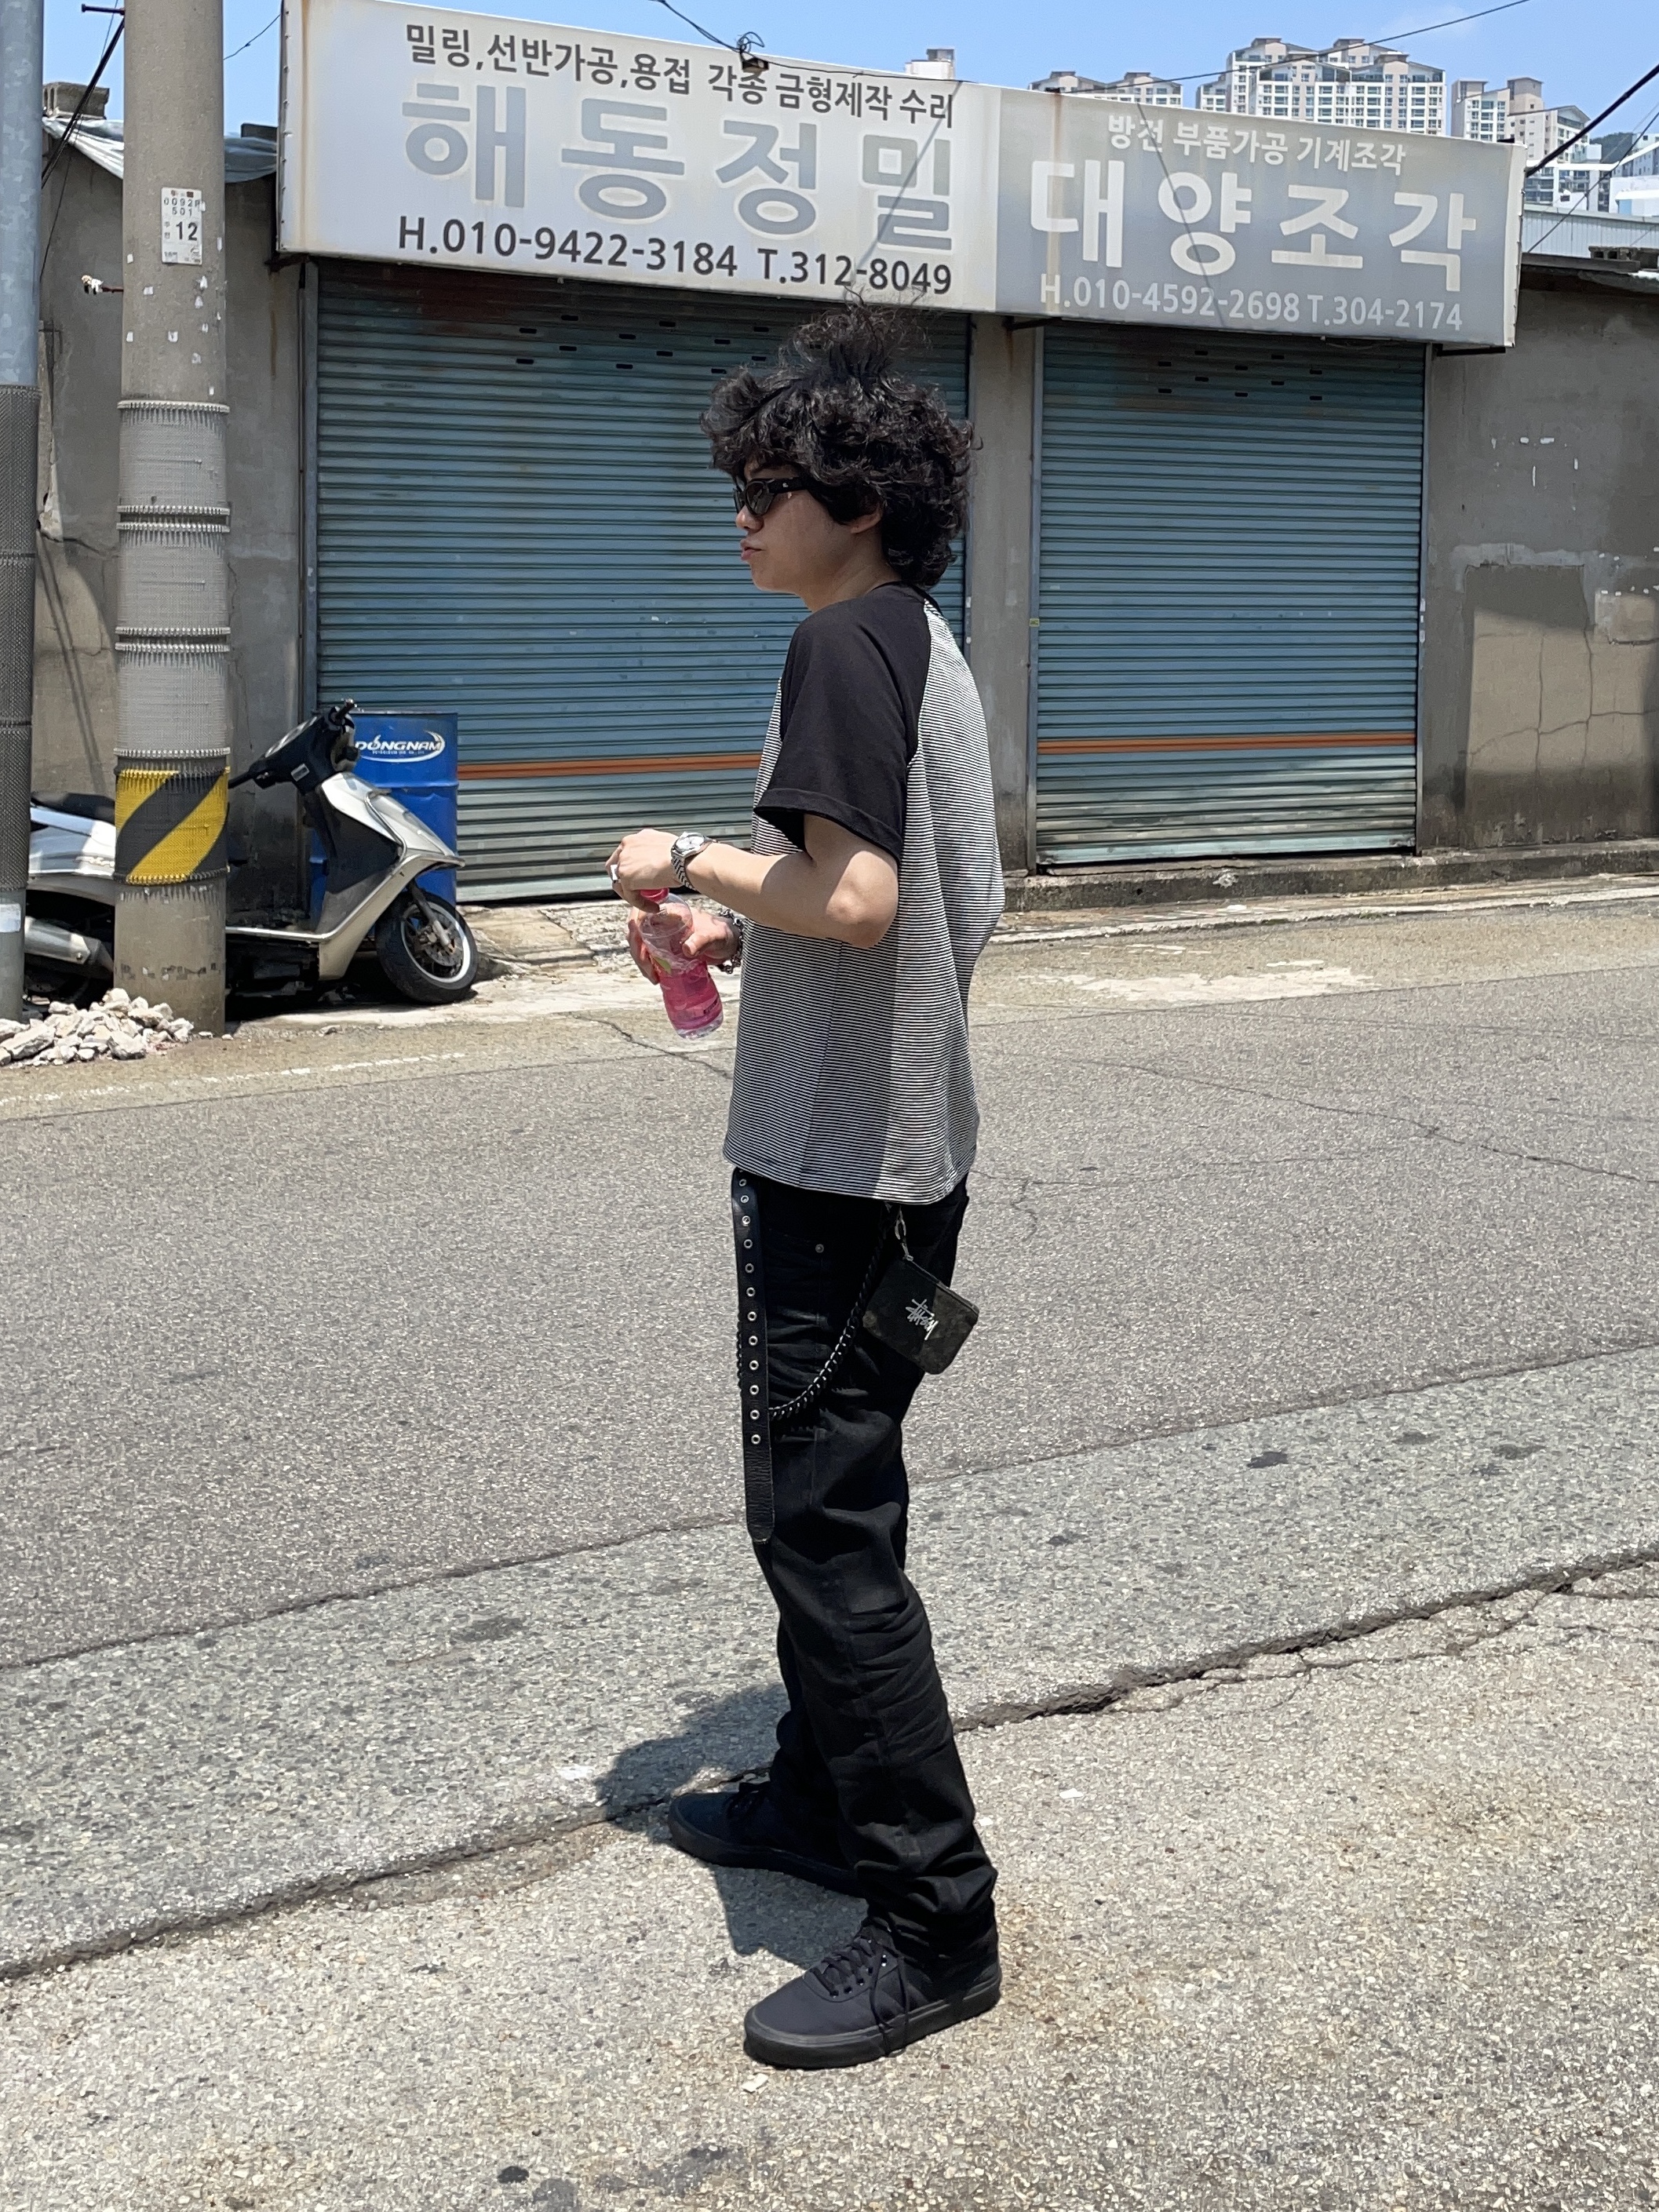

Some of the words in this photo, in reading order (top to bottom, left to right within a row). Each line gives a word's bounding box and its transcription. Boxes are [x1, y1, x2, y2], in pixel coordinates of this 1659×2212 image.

[407, 24, 690, 95] 밀링,선반가공,용접
[708, 64, 768, 105] 각종
[775, 73, 893, 121] 금형제작
[899, 89, 953, 128] 수리
[1108, 115, 1164, 152] 방전
[1173, 121, 1289, 166] 부품가공
[1296, 137, 1406, 176] 기계조각
[172, 206, 193, 217] 501
[176, 220, 199, 241] 12
[399, 216, 738, 277] H.010-9422-3184
[757, 248, 952, 294] T.312-8049
[1040, 273, 1300, 320] H.010-4592-2698
[1307, 293, 1463, 331] T.304-2174
[355, 737, 439, 751] DONGNAM
